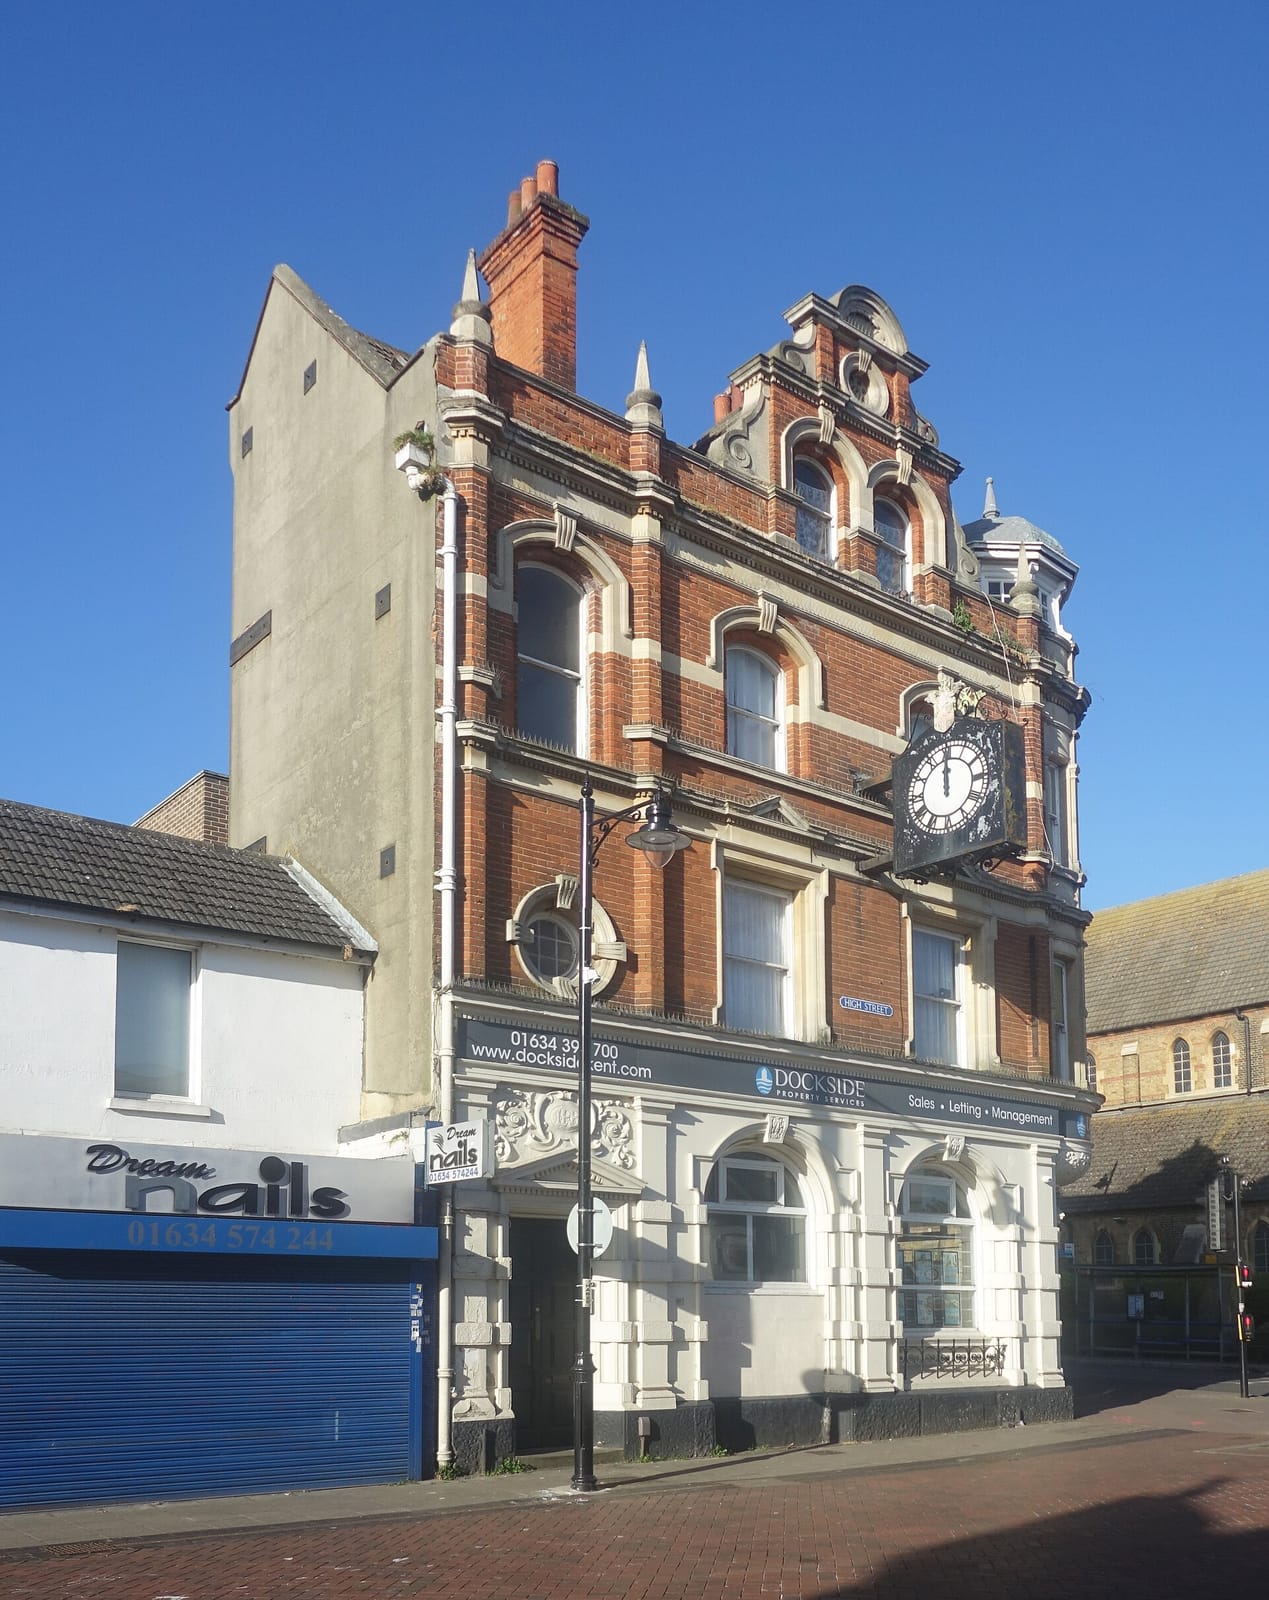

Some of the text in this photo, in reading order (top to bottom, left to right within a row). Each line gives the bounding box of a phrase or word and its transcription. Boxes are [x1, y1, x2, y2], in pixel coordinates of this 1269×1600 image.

[844, 998, 889, 1015] HIGH STREET
[511, 1030, 619, 1059] 01634 39 700
[471, 1044, 652, 1079] www.docksident.com
[774, 1068, 866, 1098] DOCKSIDE
[776, 1089, 865, 1107] PROPERTY SERVICES
[908, 1094, 1054, 1126] Sales Letting Management
[447, 1126, 477, 1141] Dream
[87, 1143, 215, 1179] Dream
[429, 1138, 478, 1170] nails
[125, 1156, 350, 1219] nails
[429, 1167, 479, 1182] 01634 574244
[127, 1220, 334, 1250] 01634 574 244
